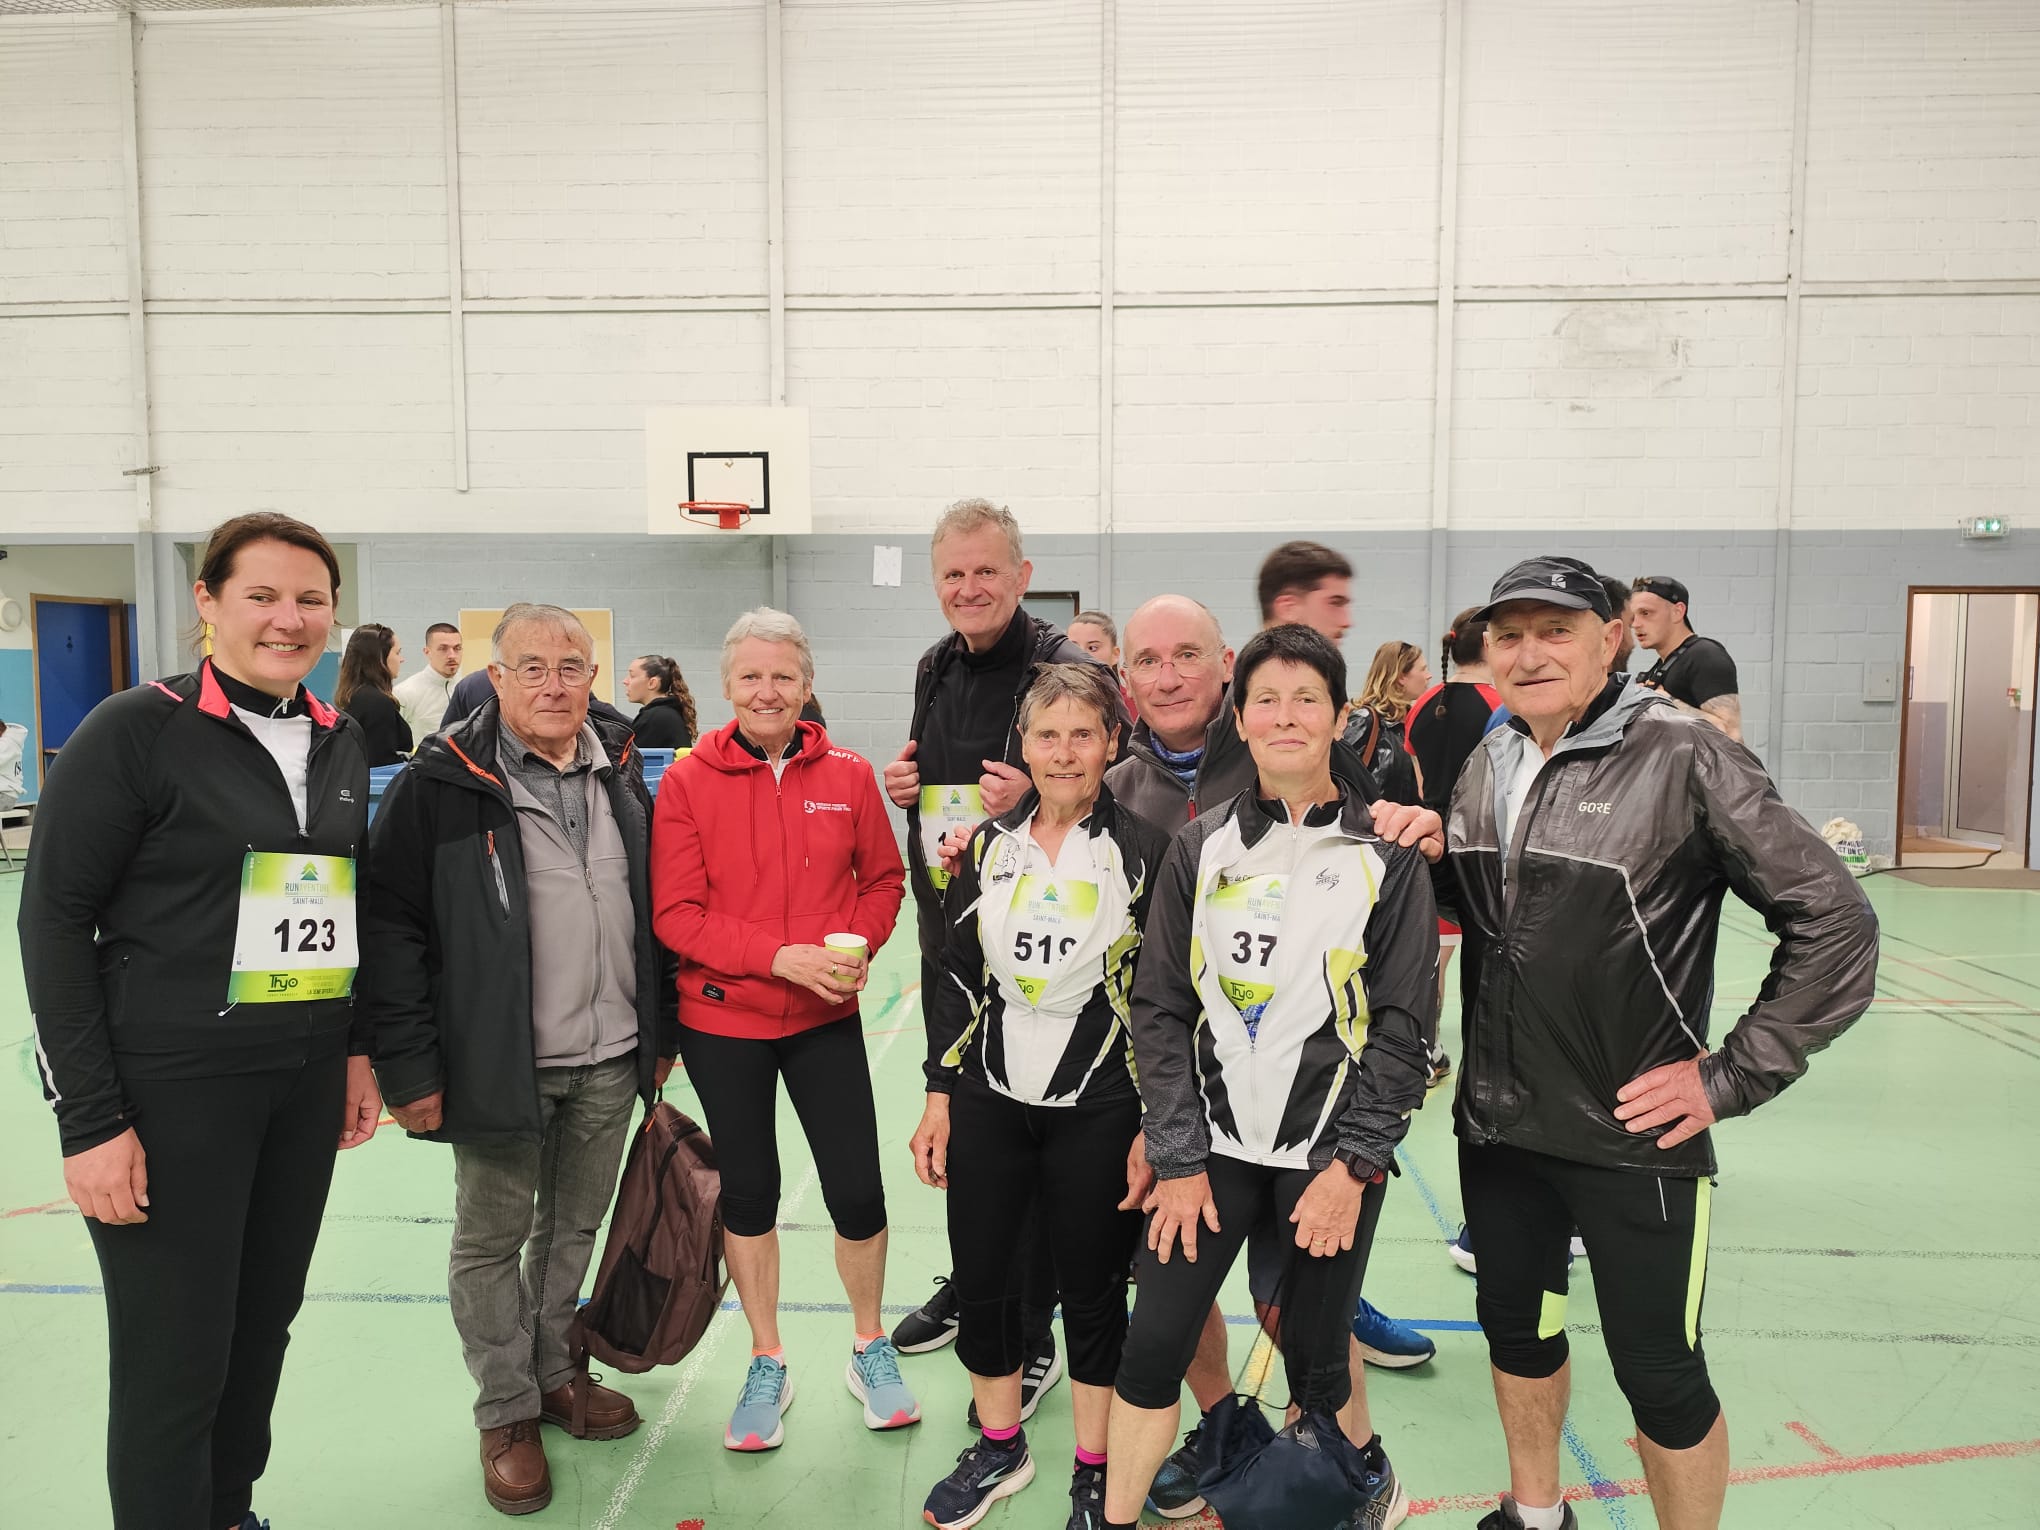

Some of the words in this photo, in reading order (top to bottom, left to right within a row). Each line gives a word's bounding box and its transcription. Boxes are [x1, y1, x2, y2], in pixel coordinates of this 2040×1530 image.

[828, 749, 854, 760] RAFT
[1578, 801, 1612, 815] GORE
[292, 897, 324, 905] SAINT-MALO
[1253, 911, 1281, 922] SAINT-MA
[274, 918, 336, 953] 123
[1231, 931, 1278, 967] 37
[267, 973, 299, 993] Thyo
